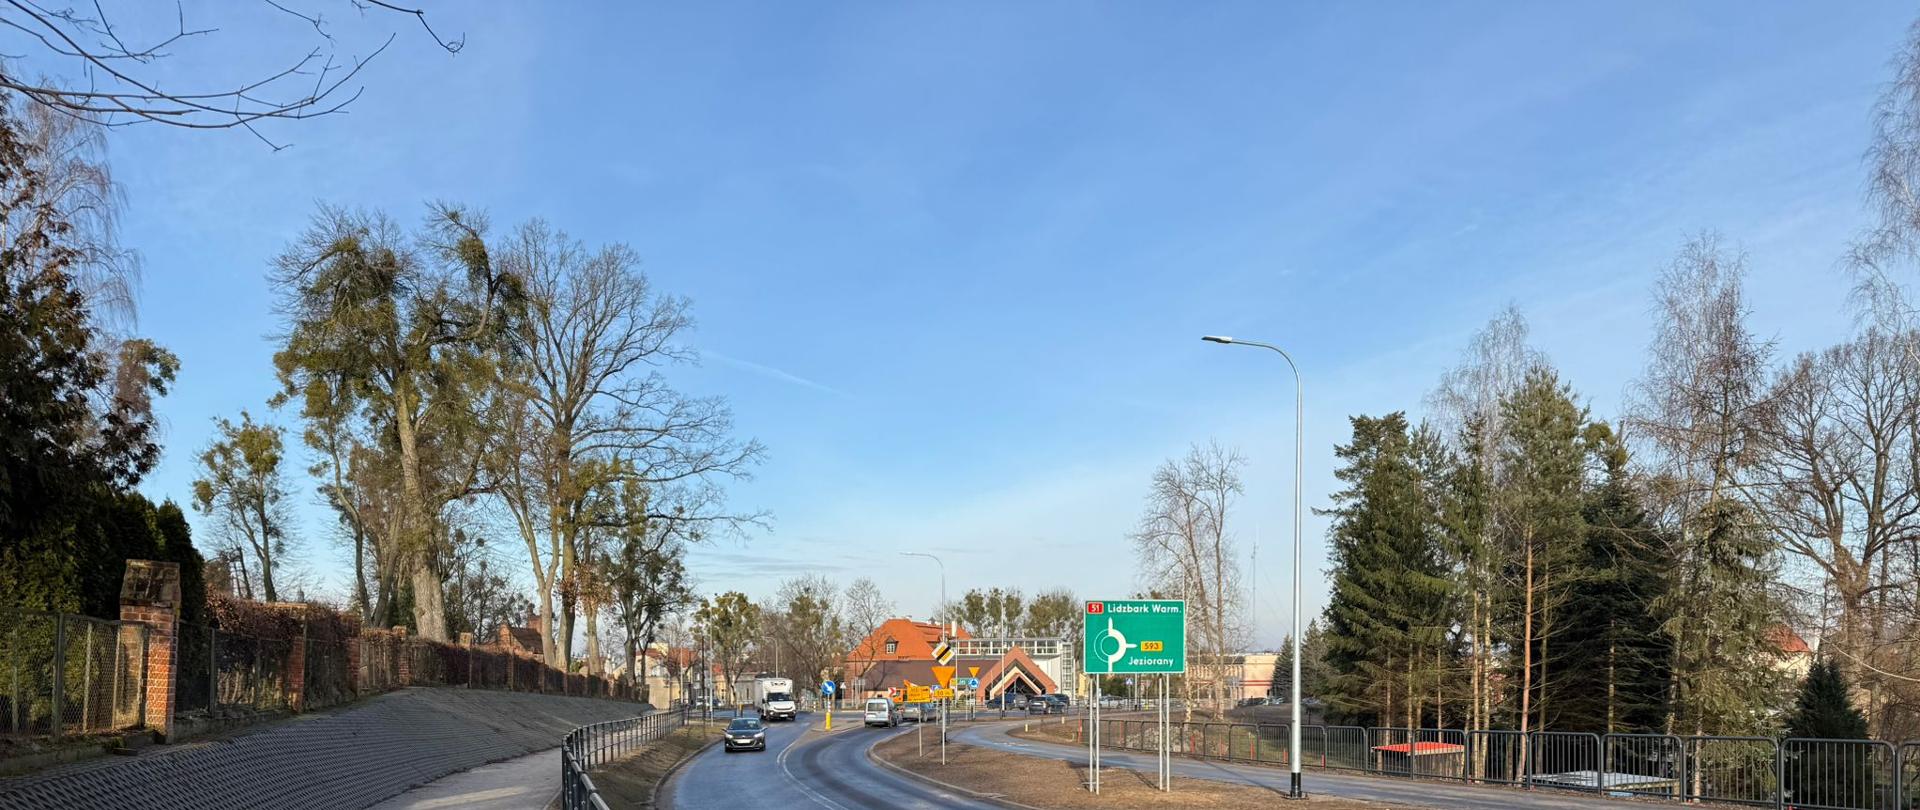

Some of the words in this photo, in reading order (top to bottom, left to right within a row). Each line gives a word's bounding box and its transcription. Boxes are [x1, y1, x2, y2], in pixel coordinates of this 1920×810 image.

[1091, 604, 1100, 612] 51
[1108, 604, 1149, 613] Lidzbark
[1152, 604, 1182, 613] Warm.
[1128, 656, 1174, 667] Jeziorany
